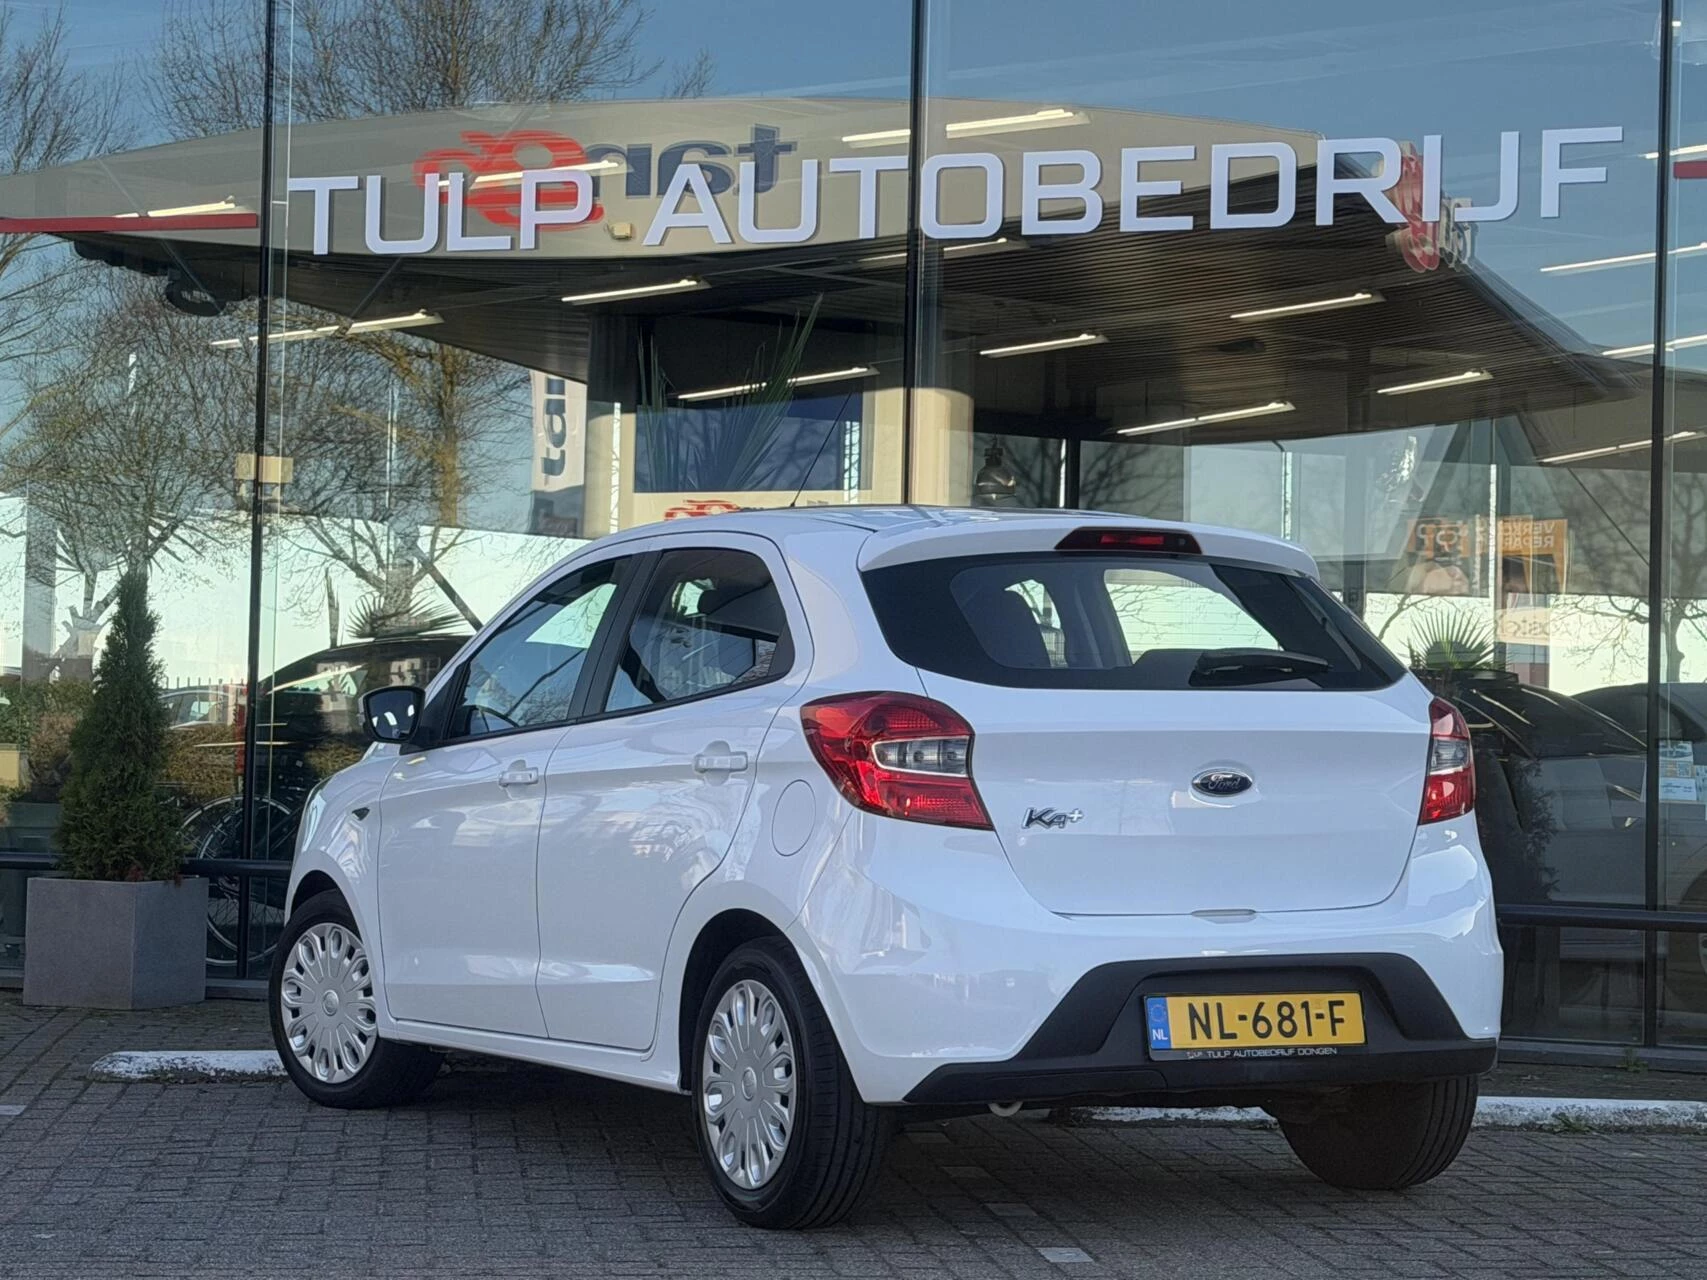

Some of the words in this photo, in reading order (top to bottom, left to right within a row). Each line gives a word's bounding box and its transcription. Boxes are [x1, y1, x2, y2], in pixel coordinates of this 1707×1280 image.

[287, 167, 594, 255] TULP
[642, 126, 1625, 247] AUTOBEDRIJF
[1187, 1000, 1345, 1040] NL-681-F
[1152, 1028, 1168, 1041] NL
[1207, 1050, 1231, 1058] TULP
[1233, 1048, 1296, 1058] AUTOBEDRIJF
[1297, 1047, 1337, 1056] DONGEN
